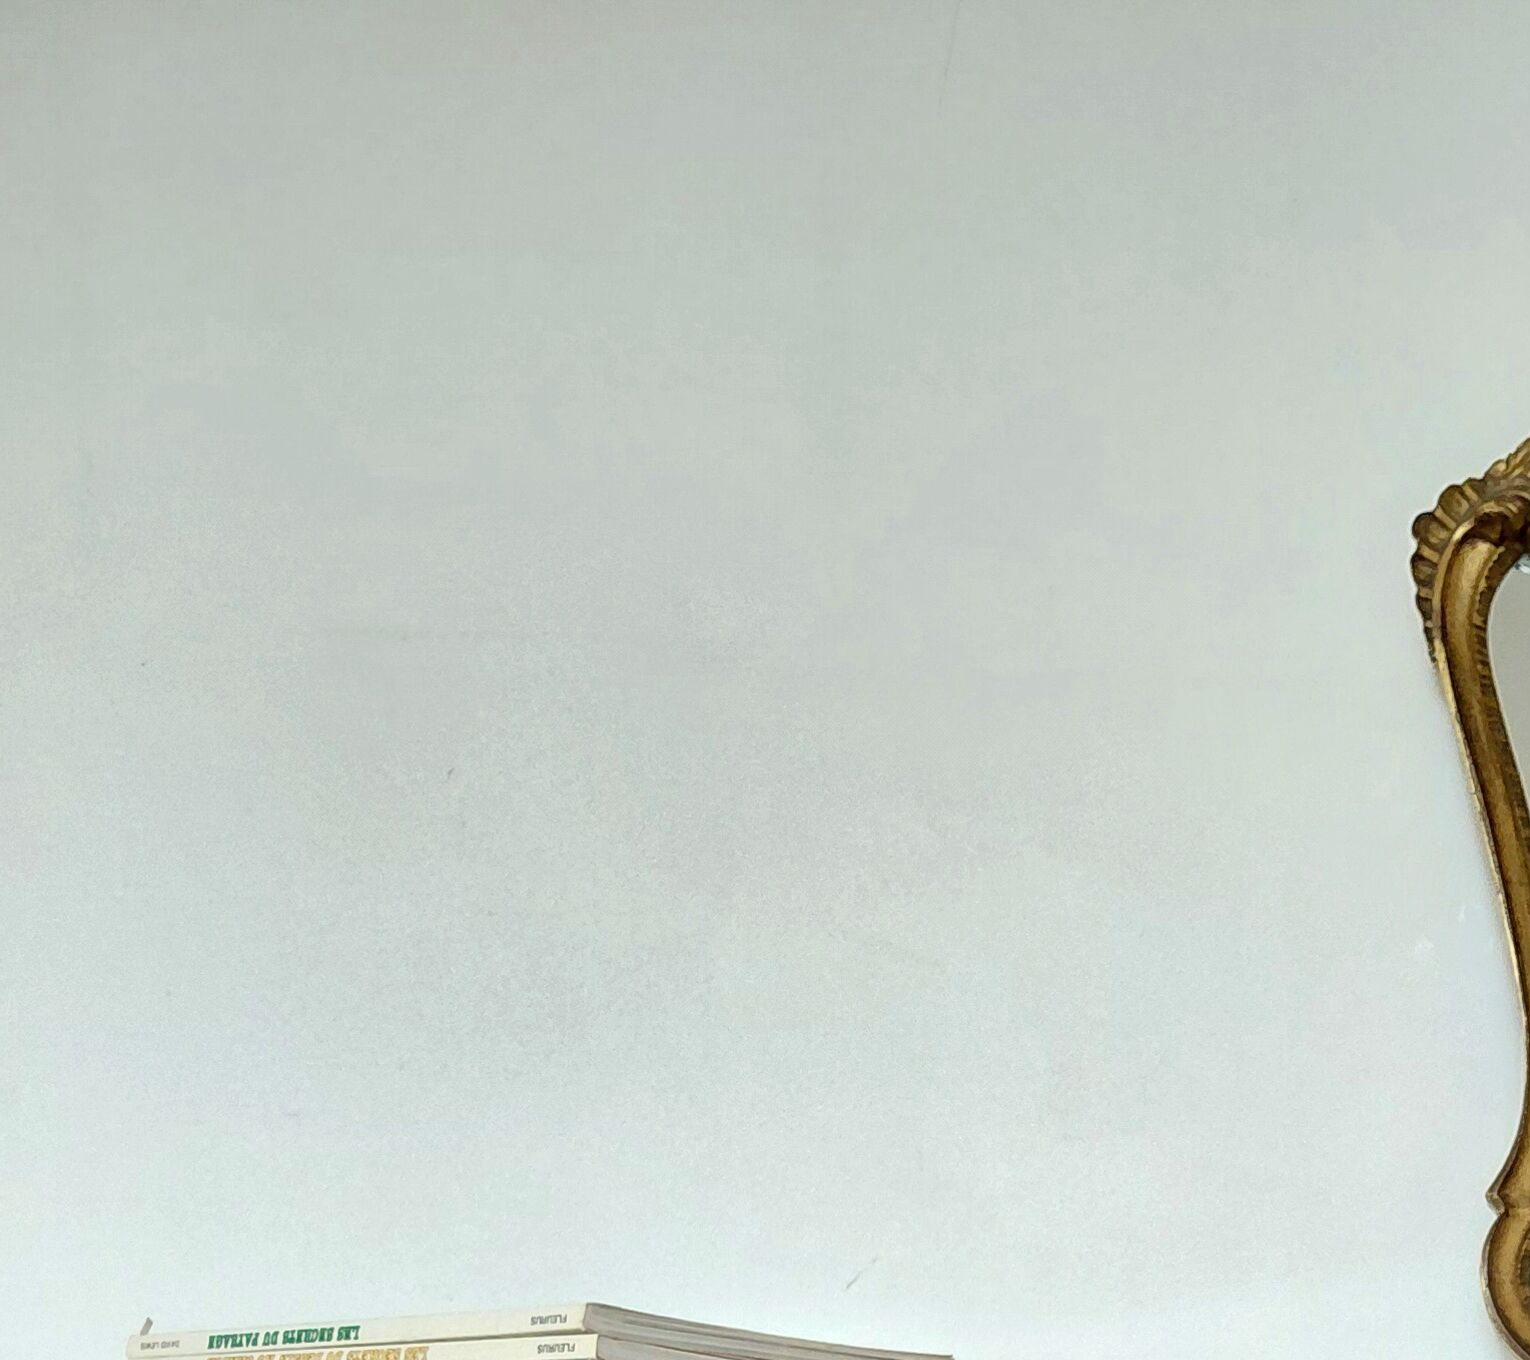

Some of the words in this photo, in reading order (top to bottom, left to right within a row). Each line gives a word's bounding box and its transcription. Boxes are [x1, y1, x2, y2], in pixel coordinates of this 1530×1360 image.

[530, 1314, 567, 1326] FLEURUS
[207, 1332, 260, 1350] PAYSAGE
[262, 1331, 279, 1347] DU
[282, 1327, 334, 1345] SECRETS
[337, 1325, 360, 1341] LES
[537, 1343, 576, 1354] FLEURUS
